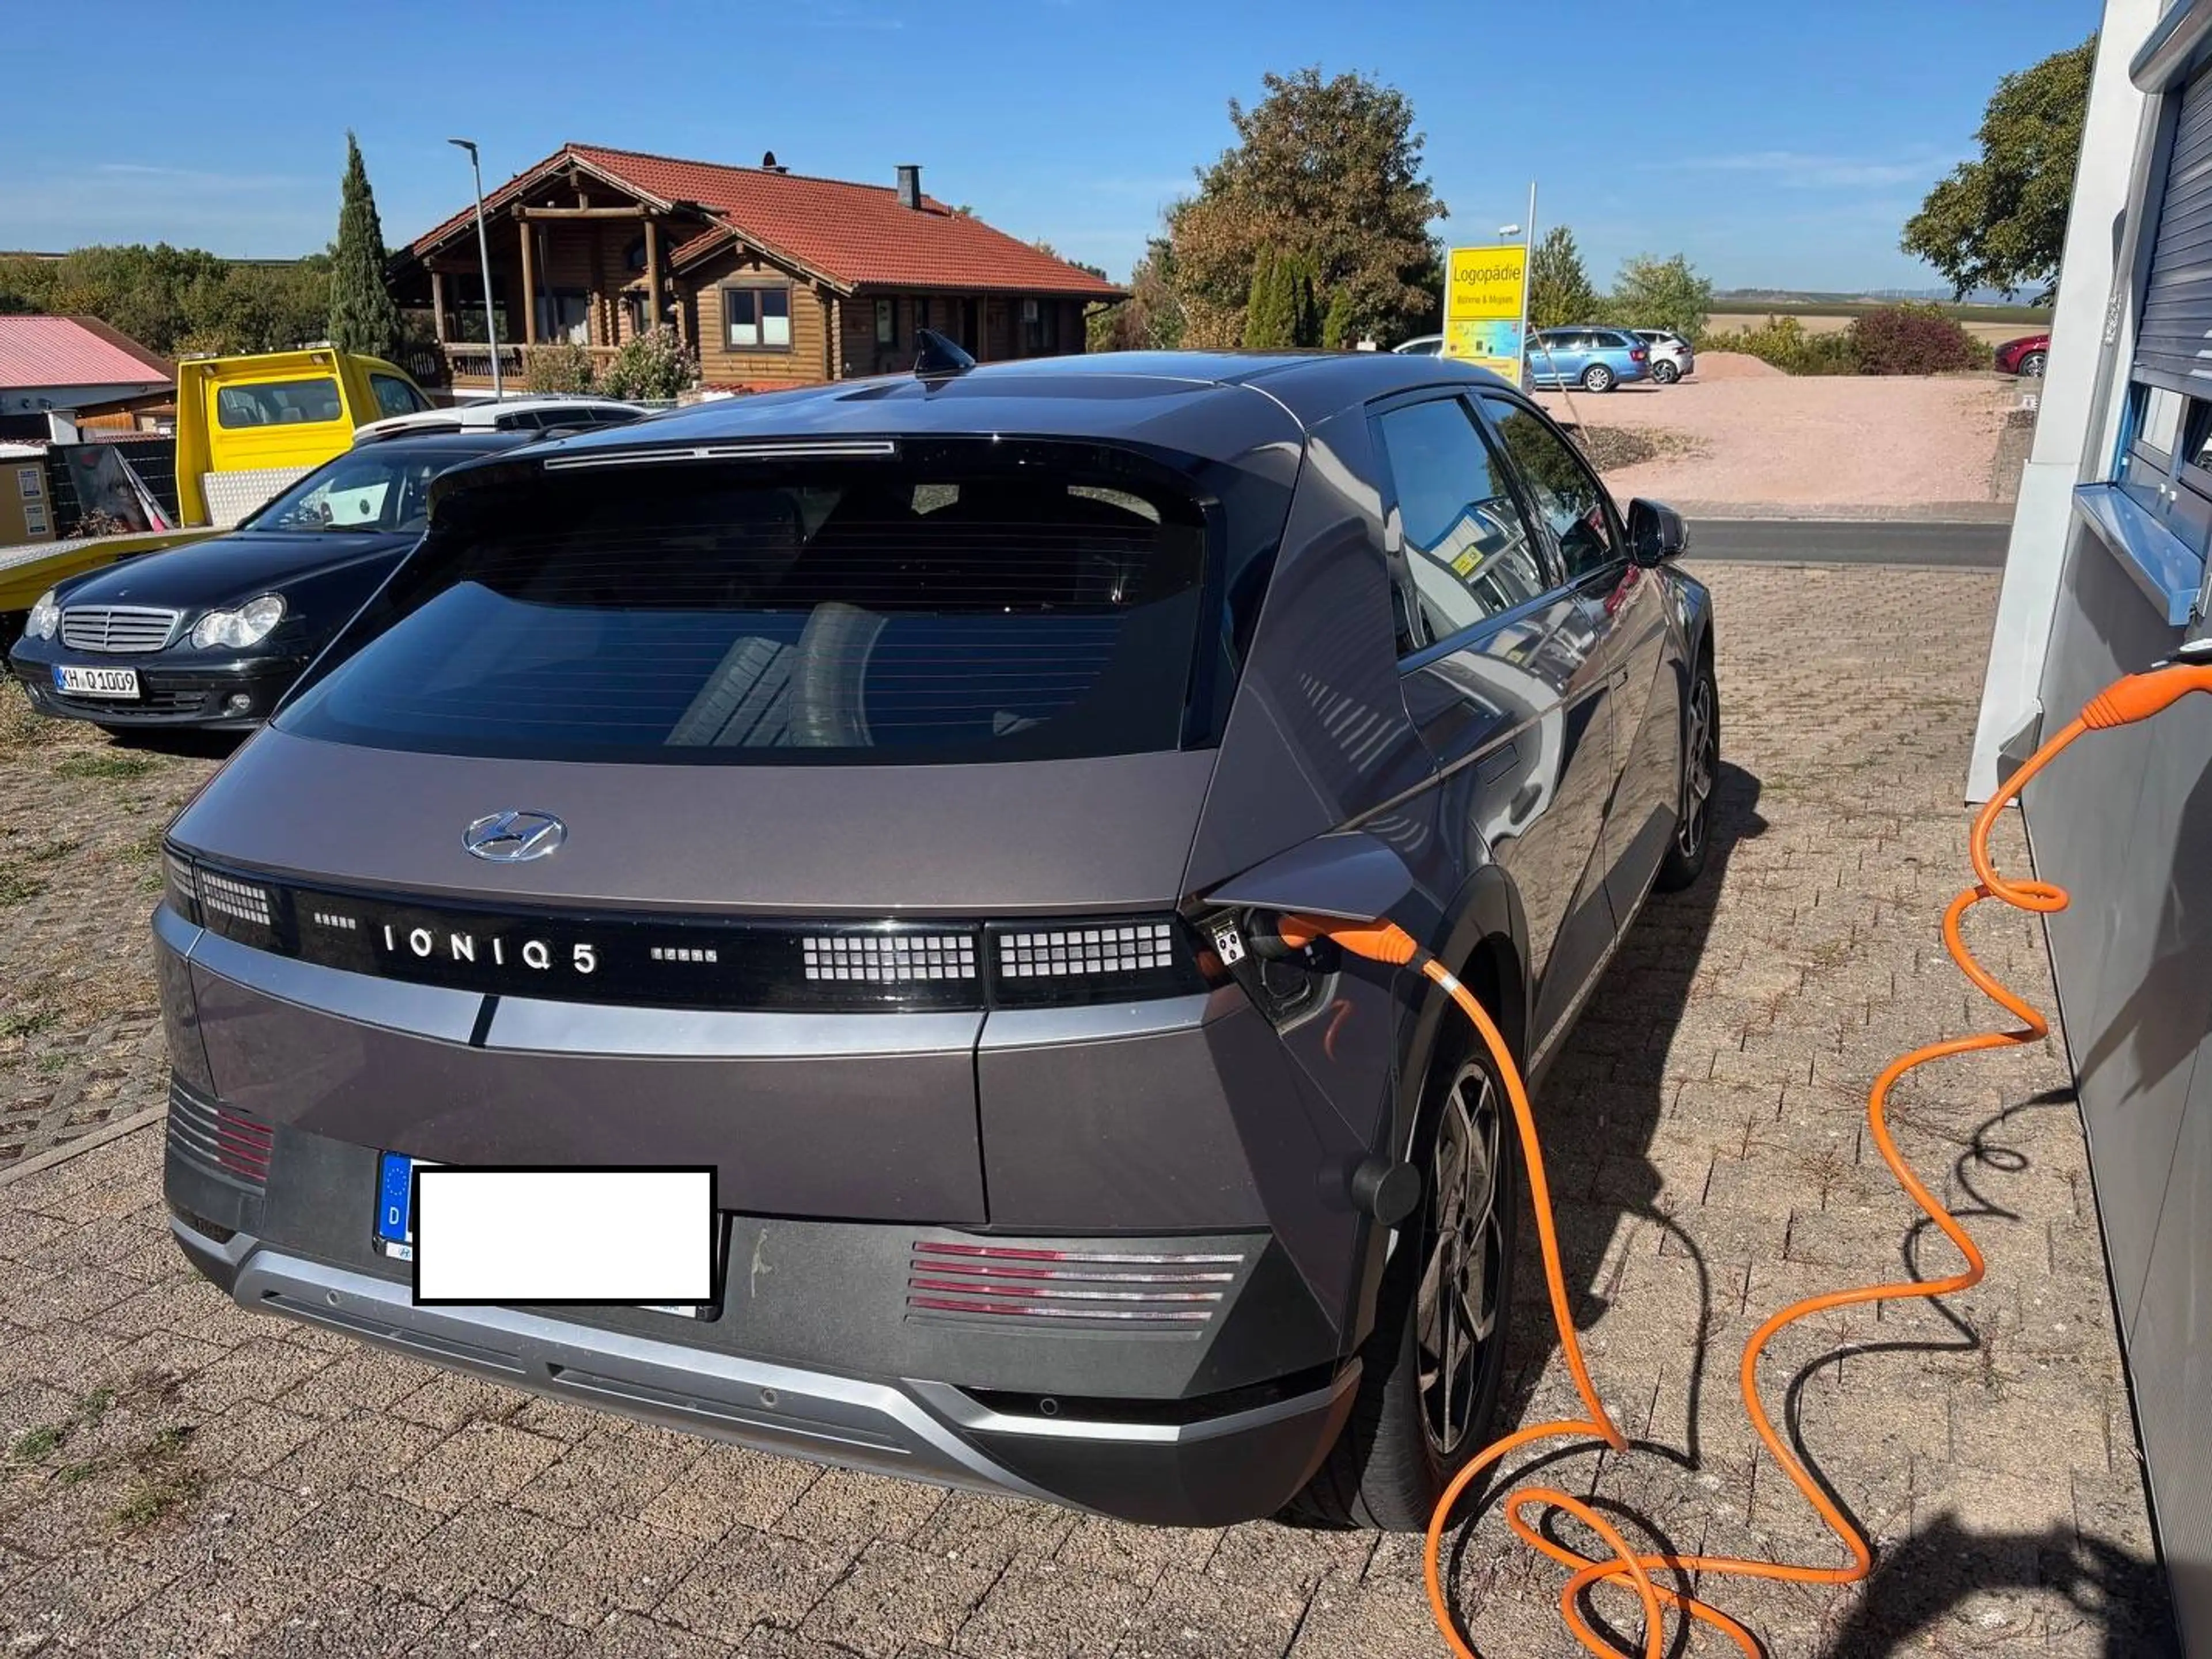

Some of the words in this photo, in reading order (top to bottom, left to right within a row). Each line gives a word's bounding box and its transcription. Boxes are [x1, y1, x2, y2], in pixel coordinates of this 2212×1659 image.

[1454, 263, 1520, 286] Logopädie
[63, 669, 79, 688] KH
[384, 925, 551, 970] IONIQ
[573, 943, 595, 974] 5
[388, 1206, 399, 1225] D
